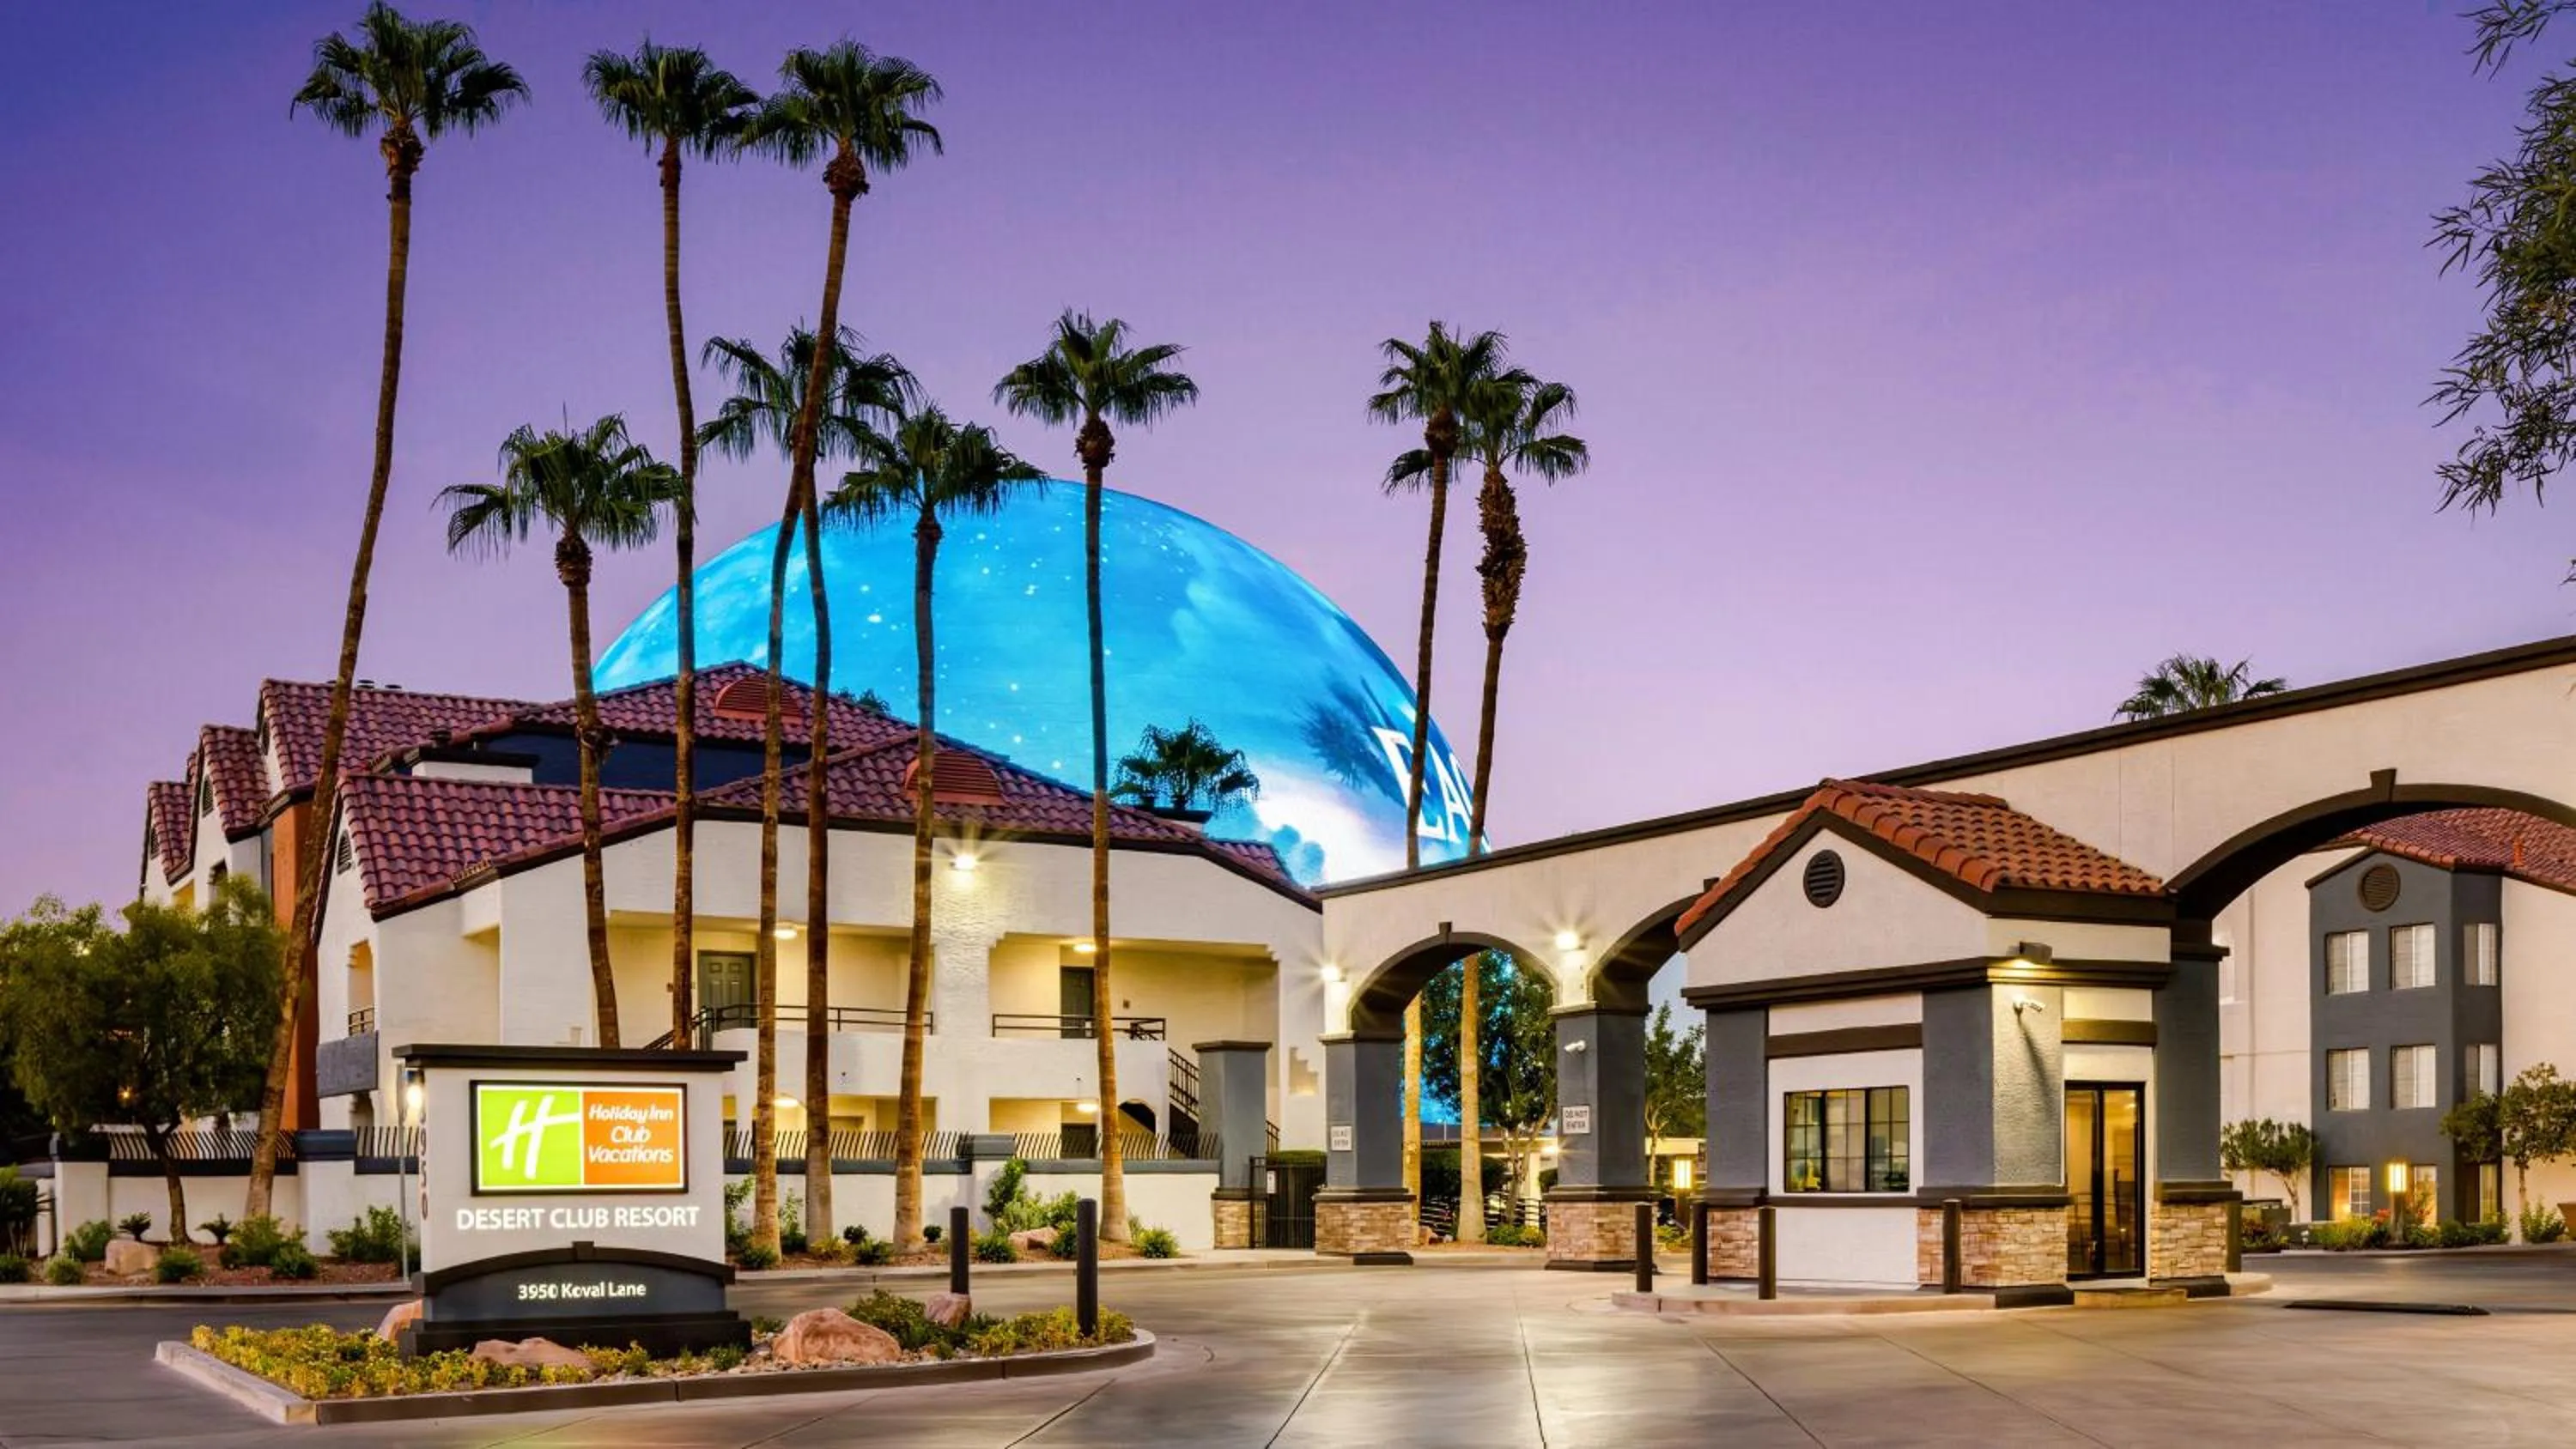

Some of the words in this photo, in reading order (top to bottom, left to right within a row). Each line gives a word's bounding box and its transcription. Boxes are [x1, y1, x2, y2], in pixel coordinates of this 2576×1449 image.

[588, 1103, 647, 1124] Holiday
[648, 1104, 674, 1120] Inn
[611, 1125, 652, 1143] Club
[588, 1144, 674, 1163] Vacations
[456, 1208, 545, 1230] DESERT
[550, 1208, 609, 1229] CLUB
[614, 1206, 700, 1228] RESORT
[518, 1283, 559, 1300] 3950
[561, 1281, 605, 1299] Koval
[607, 1281, 647, 1298] Lane
